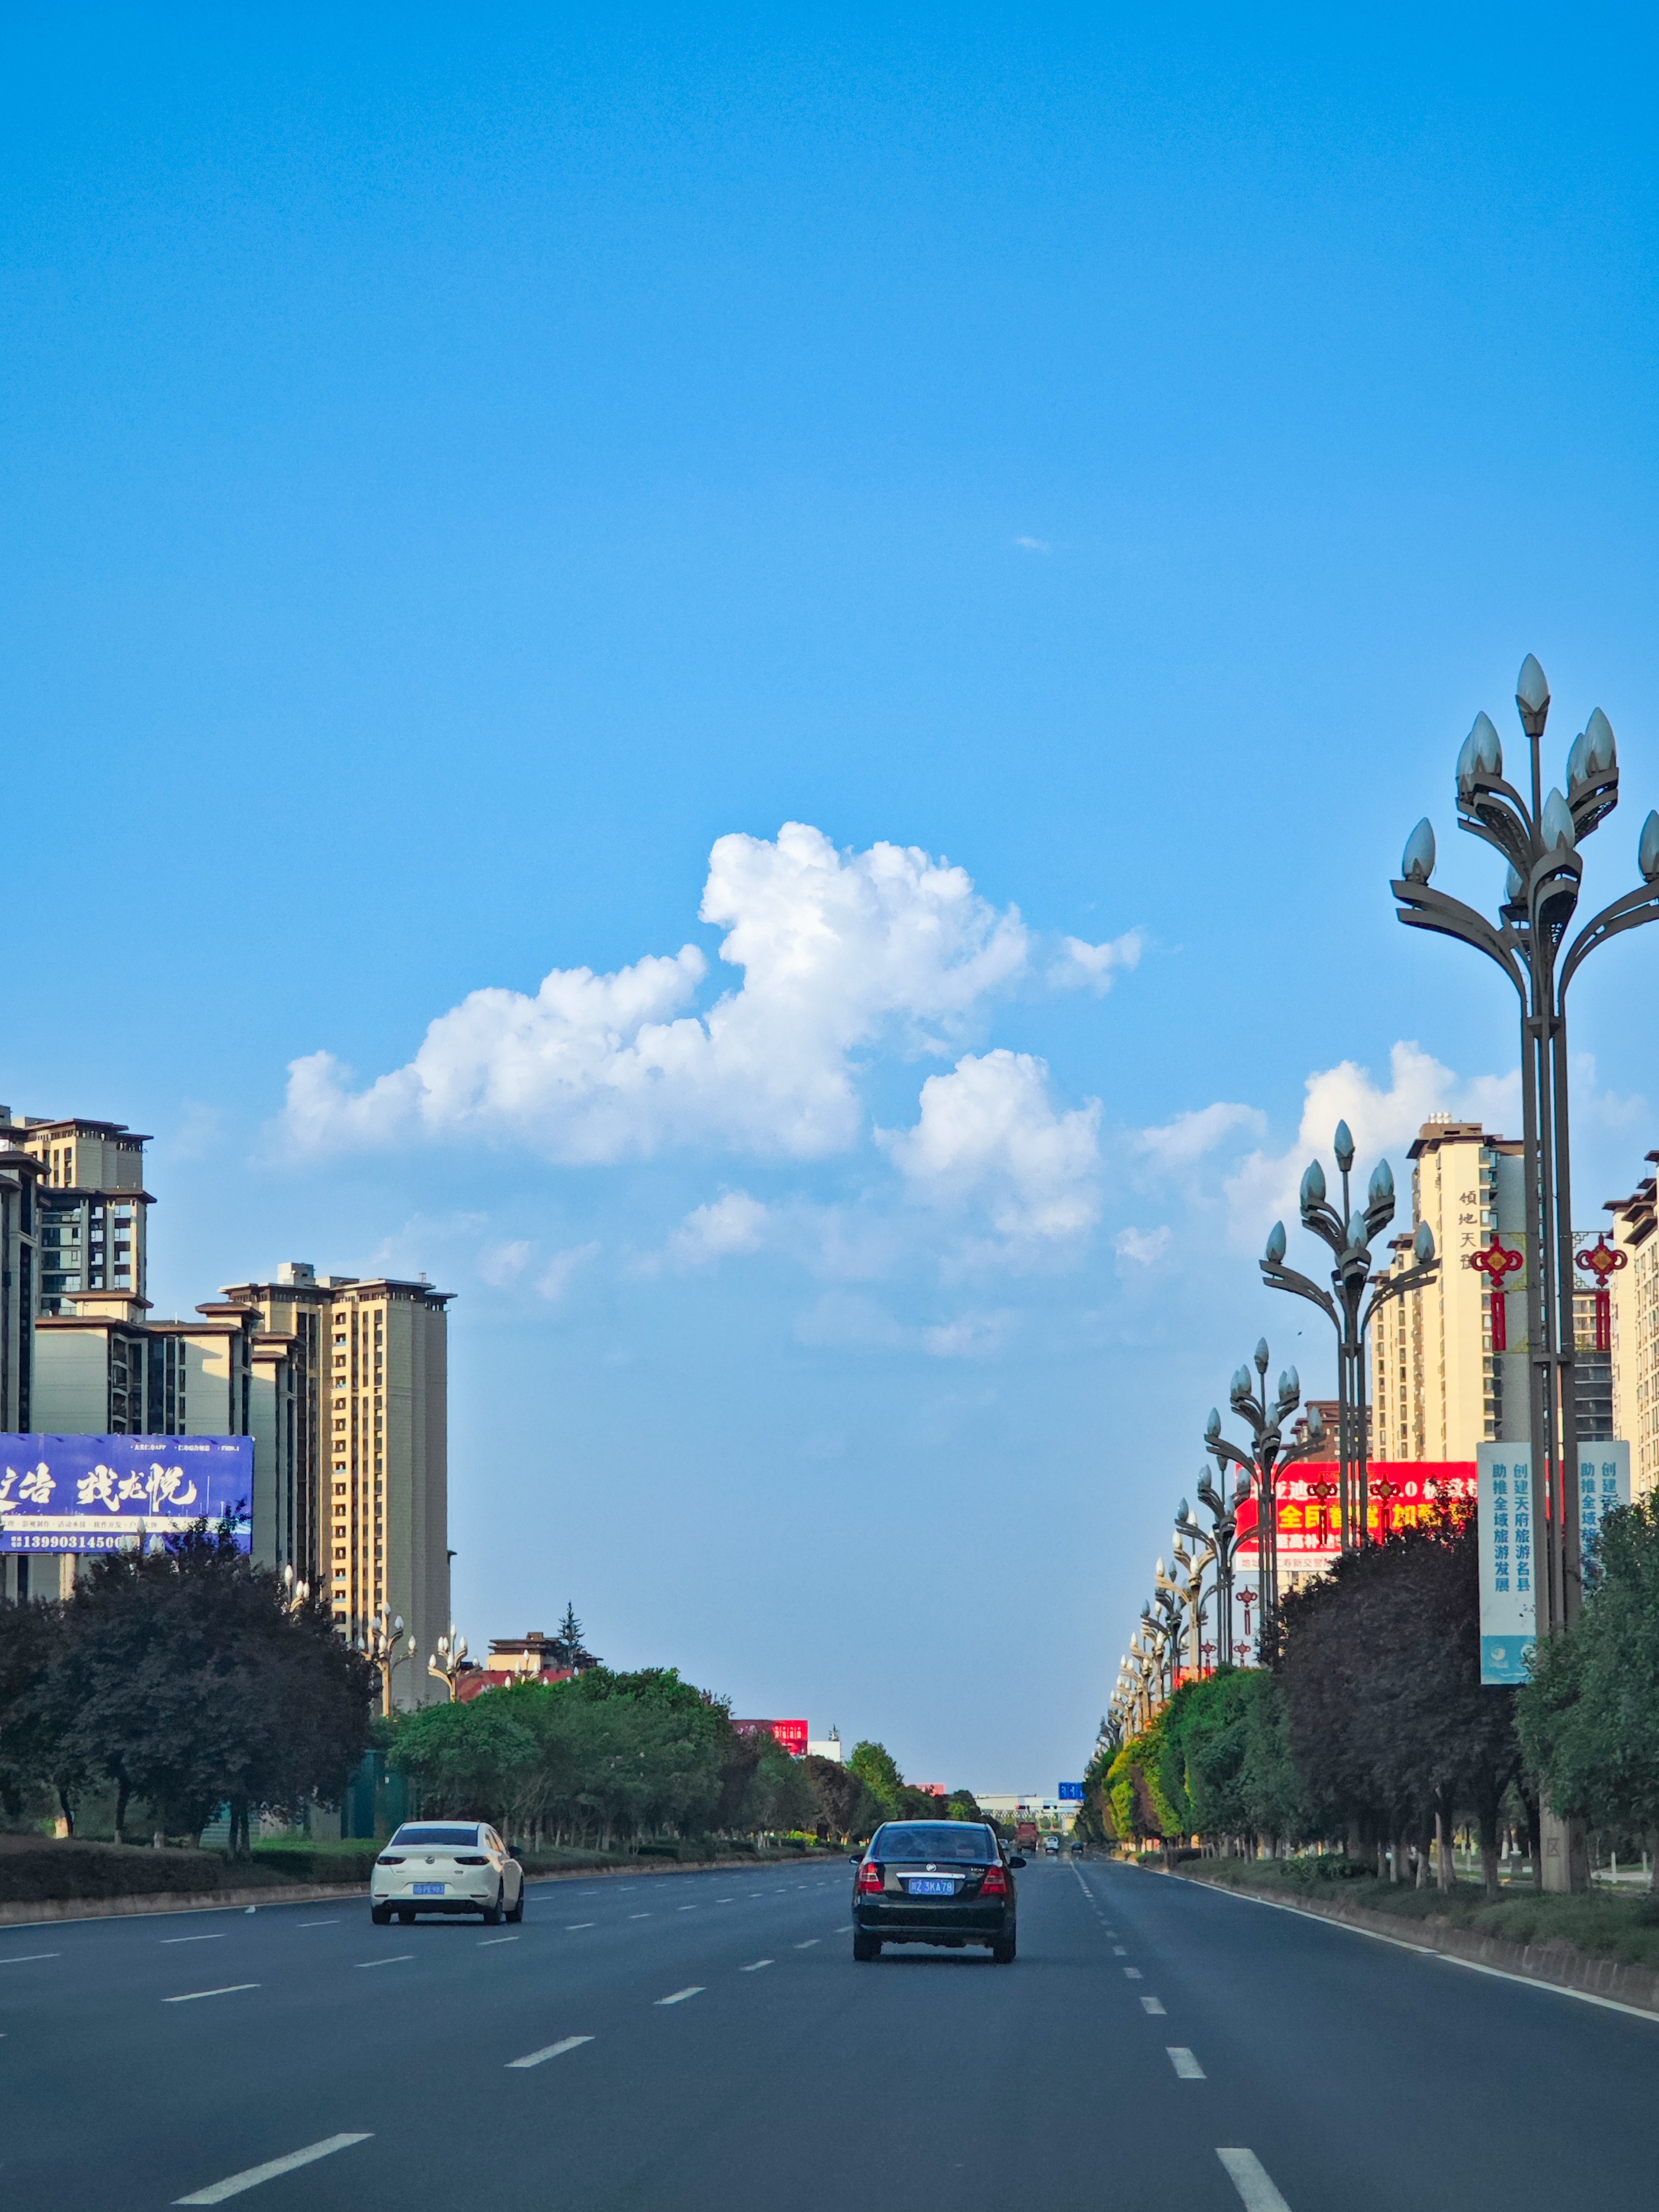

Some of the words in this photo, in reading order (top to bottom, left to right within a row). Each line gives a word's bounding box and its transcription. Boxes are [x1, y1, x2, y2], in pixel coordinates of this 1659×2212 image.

[1493, 1464, 1510, 1593] 助推全域旅游发展
[1513, 1463, 1530, 1592] 创建天府旅游名县
